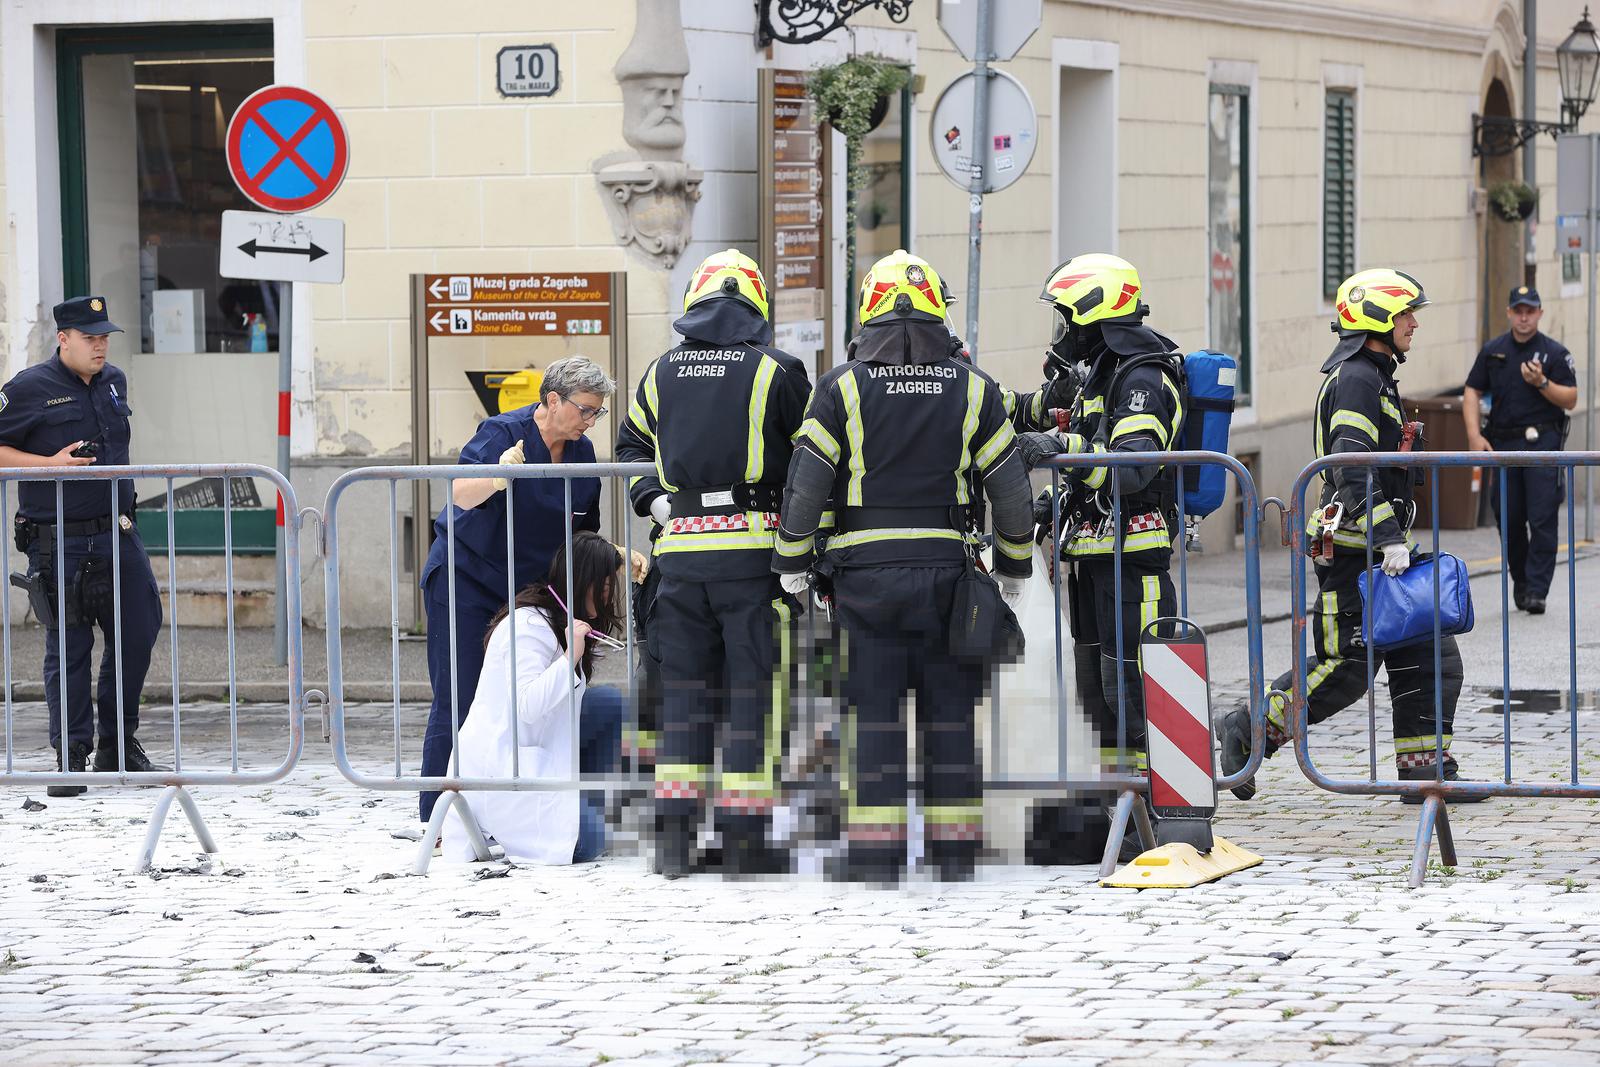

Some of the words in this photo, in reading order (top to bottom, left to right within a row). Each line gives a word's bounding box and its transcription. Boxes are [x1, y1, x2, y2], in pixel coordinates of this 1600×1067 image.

[515, 52, 544, 79] 10
[528, 82, 550, 90] MARKA
[473, 276, 506, 291] Muzej
[509, 277, 541, 291] grada
[543, 276, 588, 290] Zagreba
[473, 291, 512, 300] Museum
[513, 290, 524, 300] of
[524, 290, 539, 300] the
[540, 290, 557, 301] City
[559, 290, 569, 300] of
[569, 289, 602, 300] Zagreb
[474, 309, 525, 321] Kamenita
[528, 310, 557, 321] vrata
[474, 323, 502, 333] Stone
[502, 323, 523, 333] Gate
[669, 349, 746, 363] VATROGASCI
[677, 364, 726, 378] ZAGREB
[867, 364, 957, 379] VATROGASCI
[885, 381, 943, 395] ZAGREB
